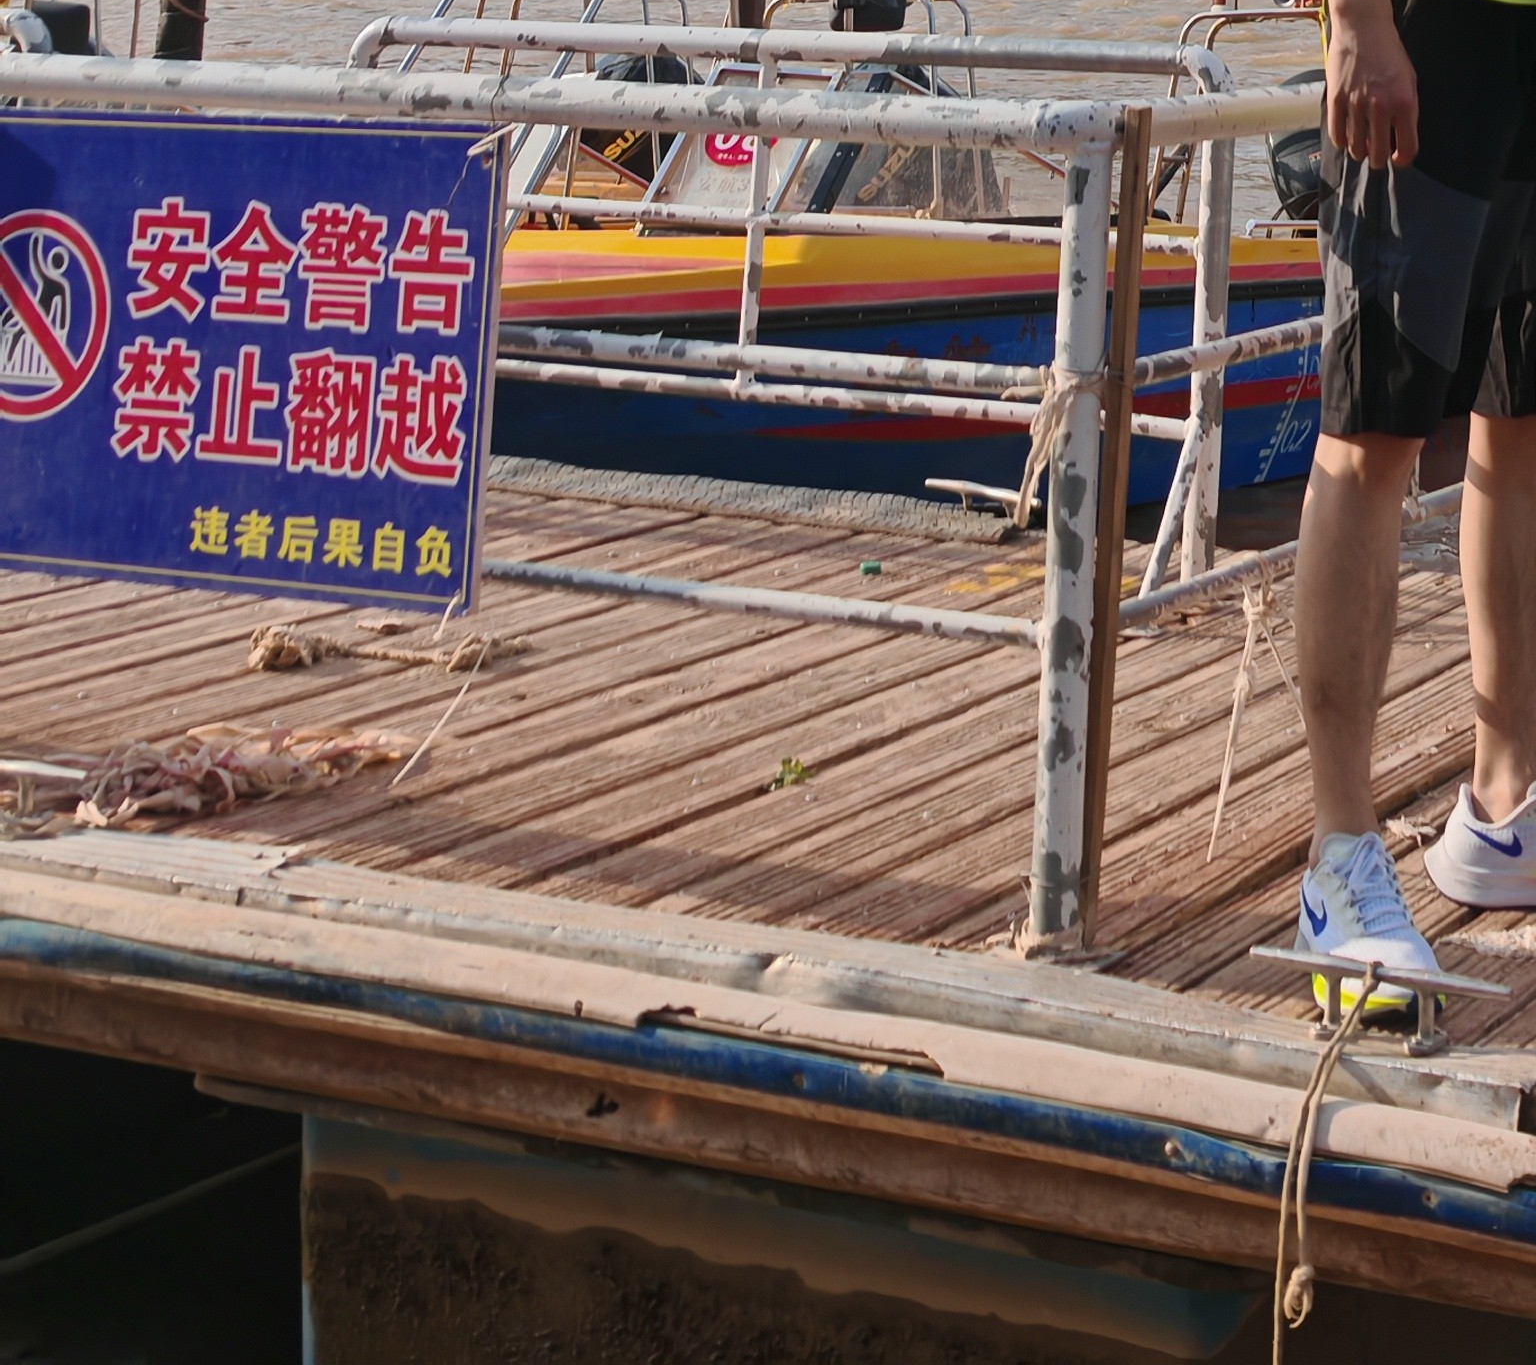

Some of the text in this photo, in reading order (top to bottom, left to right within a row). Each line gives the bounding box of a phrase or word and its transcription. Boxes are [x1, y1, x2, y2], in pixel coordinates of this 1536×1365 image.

[128, 196, 475, 335] 安全警告
[110, 336, 468, 486] 禁止翻越
[189, 505, 453, 578] 违者后果自负
